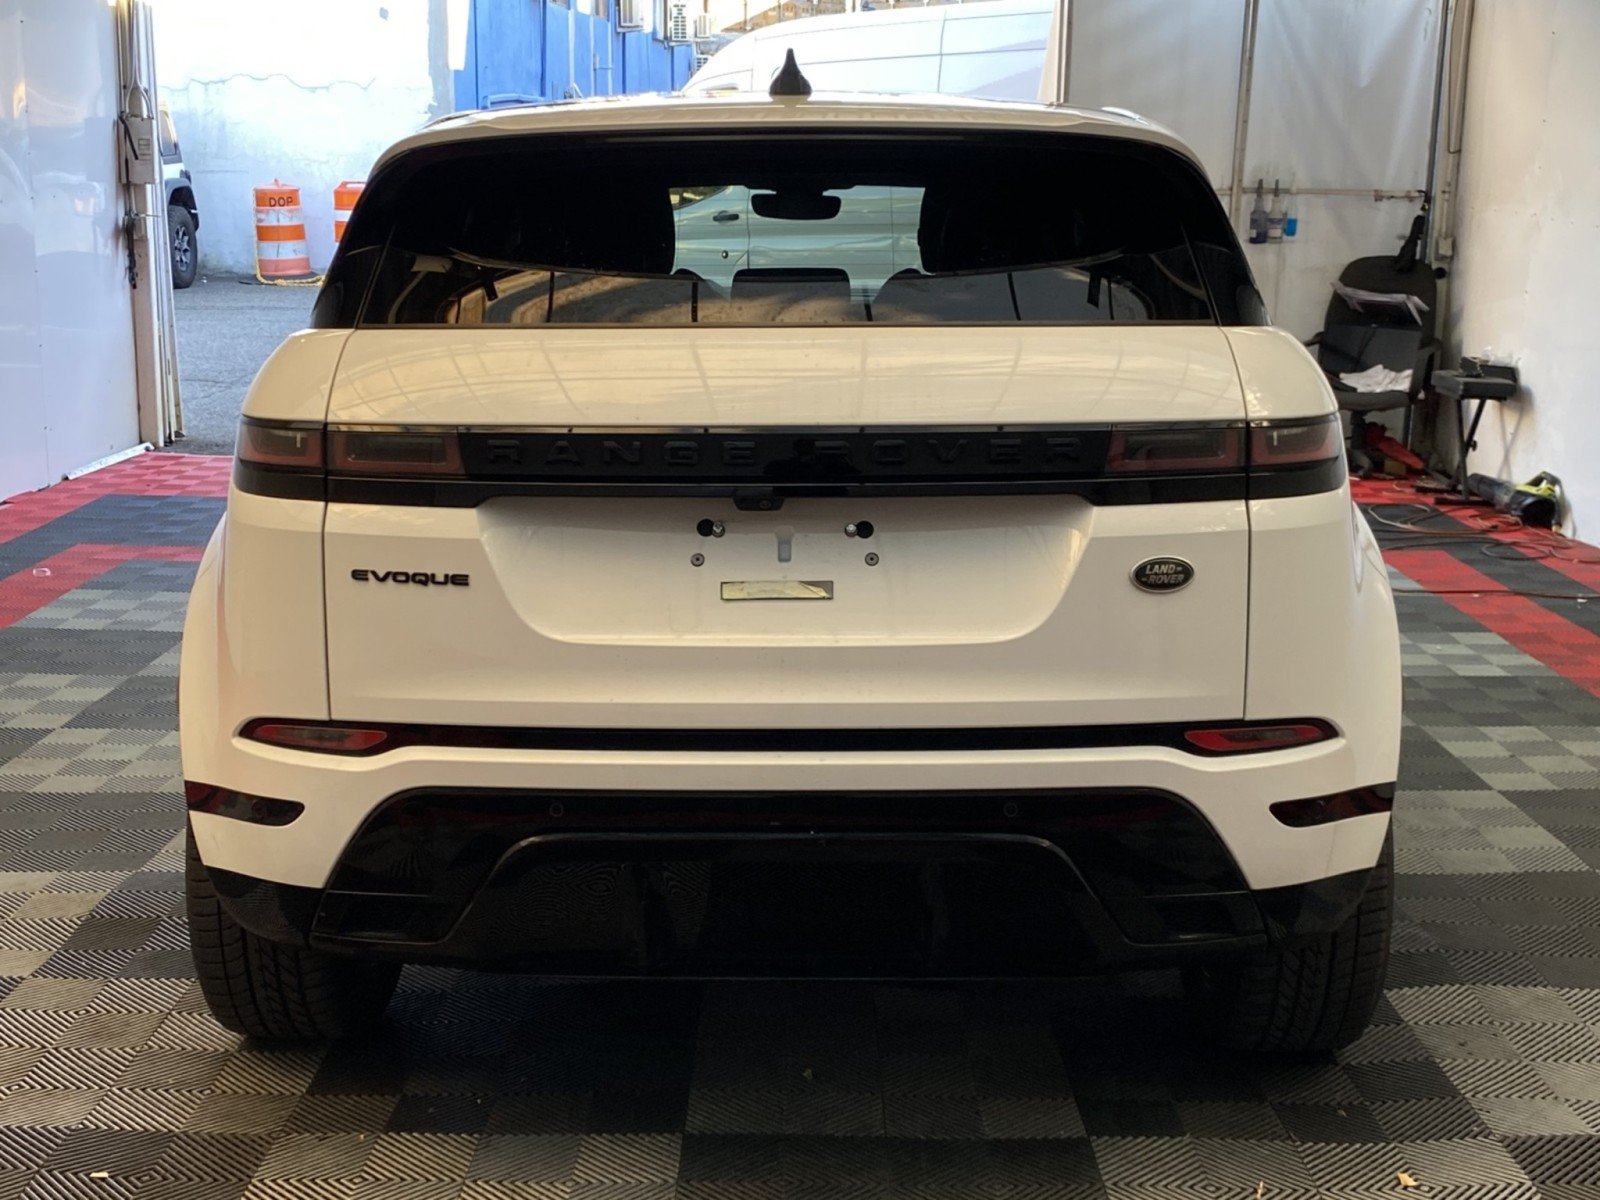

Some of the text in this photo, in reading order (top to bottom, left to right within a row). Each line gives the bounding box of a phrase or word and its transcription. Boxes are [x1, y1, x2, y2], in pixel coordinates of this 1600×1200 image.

[269, 196, 293, 207] DOP
[487, 440, 756, 465] RANGE
[1146, 564, 1176, 574] LAND
[351, 568, 470, 587] EVOQUE
[1148, 574, 1184, 584] ROVER
